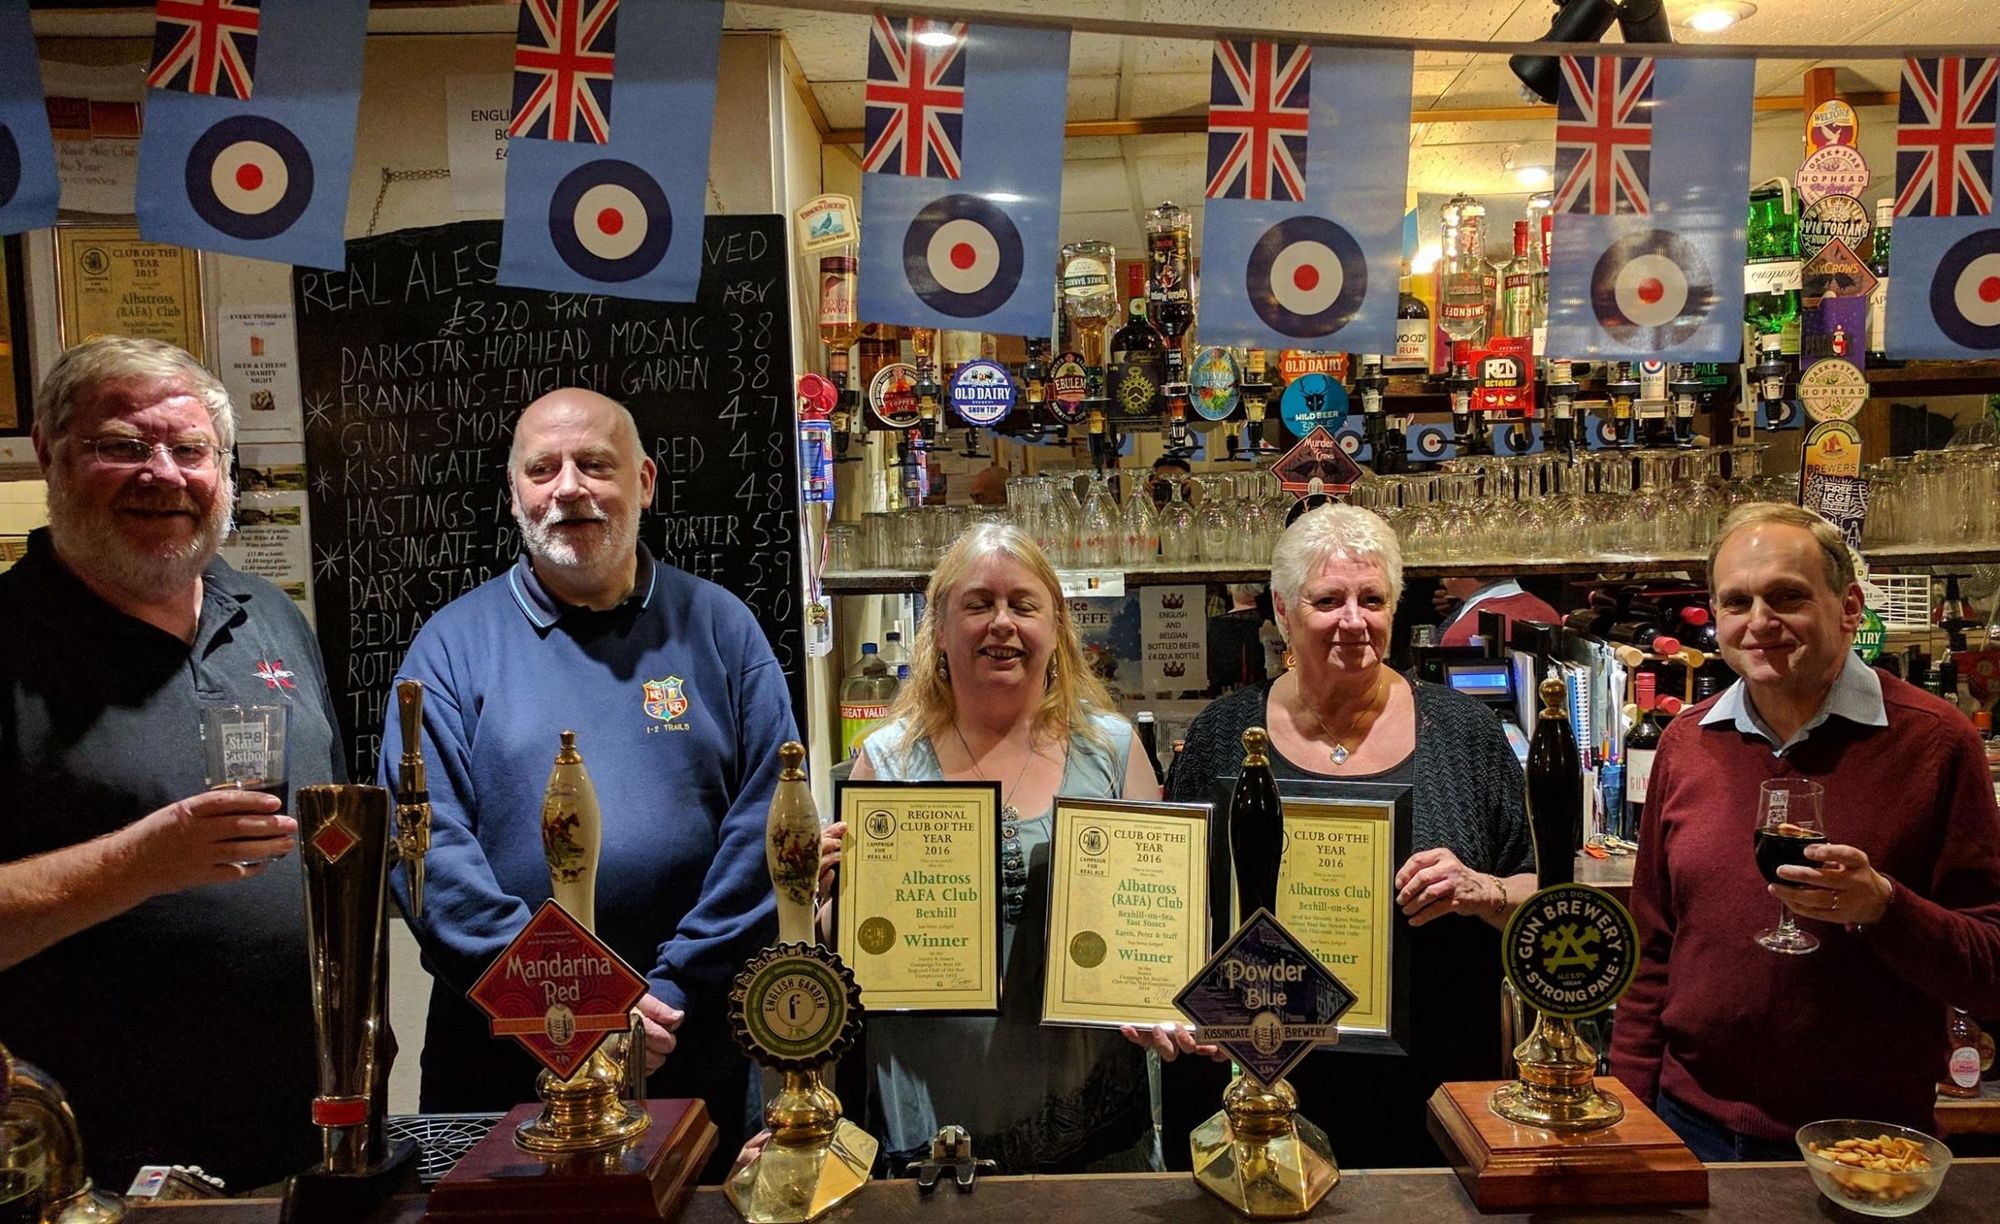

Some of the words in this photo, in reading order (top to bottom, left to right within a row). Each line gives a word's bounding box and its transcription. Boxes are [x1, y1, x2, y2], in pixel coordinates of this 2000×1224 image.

[471, 109, 511, 122] ENGLI
[1809, 150, 1833, 170] DARK
[1842, 150, 1861, 169] STAR
[1801, 175, 1865, 183] HOPHEAD
[1804, 220, 1862, 236] VICTORIAN
[112, 249, 141, 258] CLUB
[142, 249, 158, 258] OF
[159, 249, 178, 258] THE
[133, 259, 159, 267] YEAR
[302, 262, 391, 315] REAL
[405, 241, 500, 303] ALES
[705, 231, 768, 264] VED
[1506, 275, 1529, 287] SMIR
[122, 292, 174, 304] Albatross
[117, 306, 152, 319] (RAFA)
[157, 306, 181, 317] Club
[438, 296, 530, 337] £3.20
[1444, 303, 1488, 319] SMIRNOFF
[610, 316, 705, 358] MOSAIC
[1400, 346, 1420, 355] RUM
[1285, 360, 1307, 373] OLD
[1307, 358, 1343, 372] DAIRY
[1485, 359, 1517, 379] RED
[1695, 363, 1719, 375] PALE
[621, 356, 709, 395] GARDEN
[1808, 364, 1830, 383] DARK
[1839, 364, 1860, 383] STAR
[1485, 379, 1517, 388] OCTOBER
[955, 387, 975, 400] OLD
[977, 387, 1011, 400] DAIRY
[1802, 387, 1865, 396] HOPHEAD
[1295, 412, 1315, 421] WILD
[1316, 411, 1339, 420] BEER
[341, 418, 409, 456] GUN
[436, 408, 517, 448] SMOK
[1303, 438, 1334, 449] Murder
[344, 446, 510, 495] KISSINGATE-
[656, 436, 705, 475] RED
[1807, 464, 1857, 474] BREWERS
[1824, 484, 1852, 494] THREE
[1823, 491, 1851, 502] LEGS
[347, 526, 517, 576] KISSINGATE-PO
[665, 514, 741, 552] PORTER
[349, 572, 416, 611] DARK
[1158, 611, 1188, 619] ENGLISH
[349, 611, 426, 649] BEDLA
[1159, 632, 1188, 640] BELGIAN
[1853, 632, 1881, 645] AIRY
[1148, 642, 1178, 650] BOTTLED
[1179, 642, 1200, 650] BEERS
[1175, 652, 1200, 660] BOTTLE
[348, 651, 399, 687] ROTH
[841, 707, 863, 718] GREAT
[663, 723, 690, 732] TRAILS
[355, 734, 381, 770] FR
[908, 810, 967, 820] REGIONAL
[900, 822, 932, 832] CLUB
[934, 822, 950, 832] OF
[951, 822, 975, 832] THE
[922, 834, 953, 843] YEAR
[1113, 829, 1144, 840] CLUB
[1146, 831, 1162, 842] OF
[1163, 833, 1187, 843] THE
[1293, 831, 1325, 841] CLUB
[1327, 832, 1344, 842] OF
[1345, 833, 1369, 843] THE
[924, 846, 951, 855] 2016
[1135, 842, 1164, 853] YEAR
[1316, 845, 1346, 855] YEAR
[1137, 853, 1162, 864] 2016
[1318, 858, 1344, 868] 2016
[902, 871, 971, 885] Albatross
[1118, 878, 1177, 894] Albatross
[1287, 882, 1340, 897] Albatross
[1344, 886, 1371, 898] Club
[895, 888, 936, 902] RAFA
[942, 888, 978, 902] Club
[1112, 892, 1152, 910] (RAFA)
[1156, 895, 1183, 910] Club
[1570, 890, 1592, 900] DOG
[915, 907, 957, 918] Bexhill
[1298, 901, 1360, 913] Bexhill-on-Sea
[1118, 910, 1176, 922] Bexhill-on-Sea,
[1126, 918, 1141, 927] East
[1142, 919, 1167, 928] Sussex
[1518, 916, 1545, 959] GUN
[1543, 899, 1623, 952] BREWERY
[904, 933, 969, 947] Winner
[1115, 929, 1135, 938] Karen,
[1137, 930, 1153, 939] Peter
[1119, 948, 1174, 964] Winner
[1312, 948, 1358, 964] inner
[506, 951, 612, 988] Mandarina
[1223, 958, 1307, 989] Powder
[1526, 971, 1588, 1003] STRONG
[1587, 963, 1620, 997] PALE
[540, 979, 580, 1006] Red
[766, 978, 795, 1012] ENGLISH
[798, 978, 827, 1009] GARDEN
[1245, 988, 1288, 1010] Blue
[1204, 1028, 1250, 1039] KISSINGATE
[1284, 1027, 1327, 1038] BREWERY
